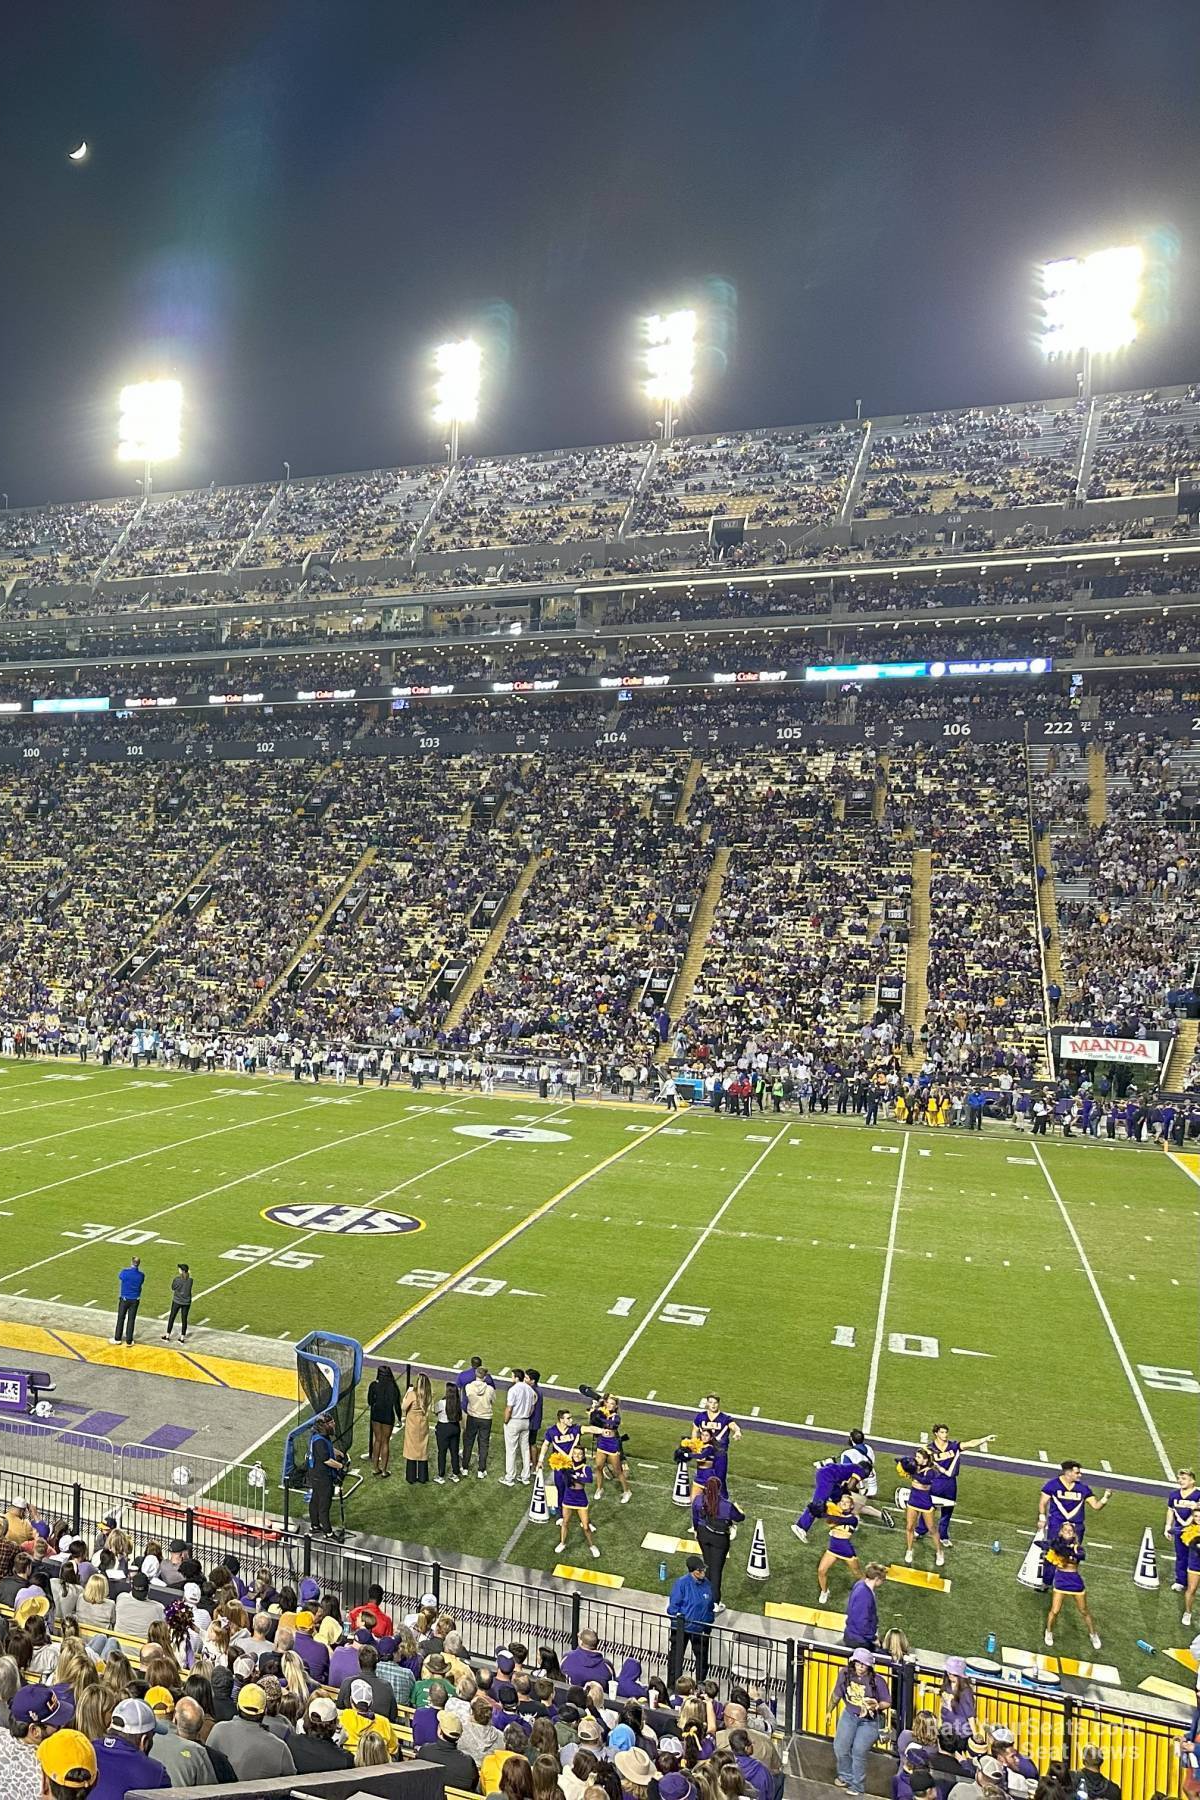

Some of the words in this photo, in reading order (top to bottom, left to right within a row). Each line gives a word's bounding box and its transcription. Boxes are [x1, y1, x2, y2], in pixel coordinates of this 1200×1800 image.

[622, 676, 643, 685] Coke
[737, 672, 759, 681] Coke
[412, 686, 430, 694] Coke
[514, 681, 533, 690] Coke
[776, 728, 802, 739] 105
[943, 724, 971, 735] 106
[1044, 722, 1073, 735] 222
[419, 738, 440, 748] 103
[603, 732, 627, 743] 104
[23, 748, 40, 757] 100
[127, 746, 143, 755] 101
[256, 742, 274, 753] 102
[1069, 1038, 1149, 1057] MANDA
[62, 1223, 160, 1246] 30
[219, 1243, 324, 1270] 25
[396, 1268, 507, 1297] 20
[606, 1296, 712, 1327] 15
[831, 1325, 939, 1358] 10
[1137, 1364, 1200, 1394] 5
[0, 1381, 19, 1395] H&E
[701, 1420, 722, 1431] LSU
[554, 1433, 575, 1444] LSU
[934, 1450, 955, 1462] LSU
[1057, 1490, 1082, 1502] LSU
[751, 1528, 768, 1571] LSU
[1140, 1537, 1158, 1578] LSU
